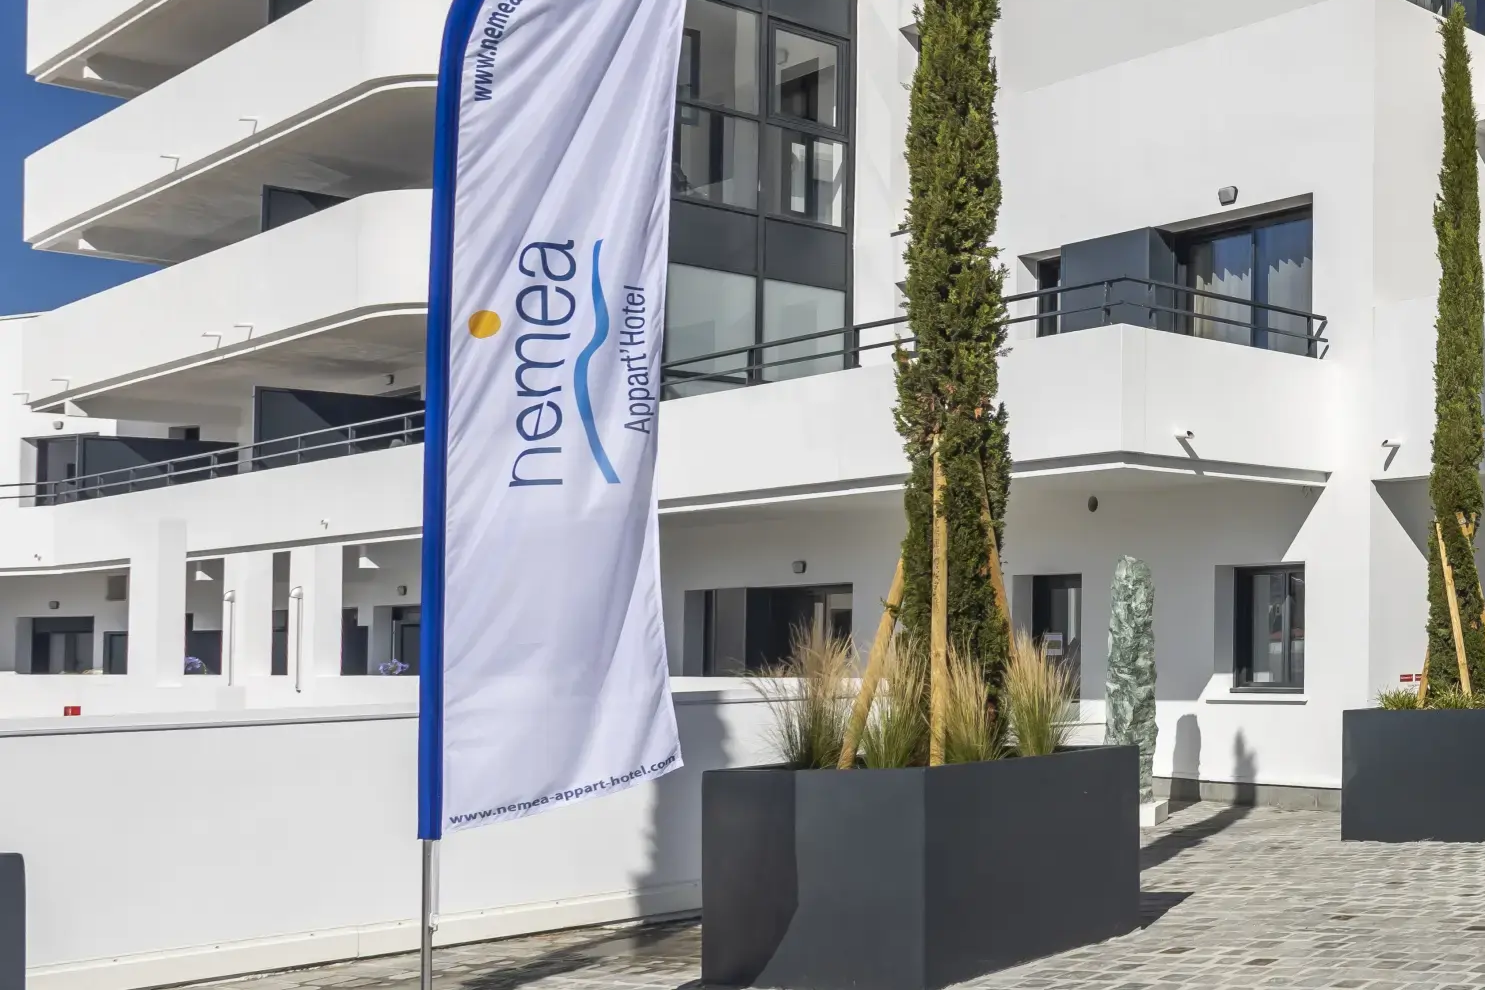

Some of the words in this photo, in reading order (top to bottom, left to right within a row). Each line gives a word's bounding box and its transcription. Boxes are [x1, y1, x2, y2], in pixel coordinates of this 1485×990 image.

[509, 239, 577, 487] nemea
[619, 285, 656, 434] Appart'Hotel
[449, 755, 676, 825] www.nemea-appart-hotel.com
